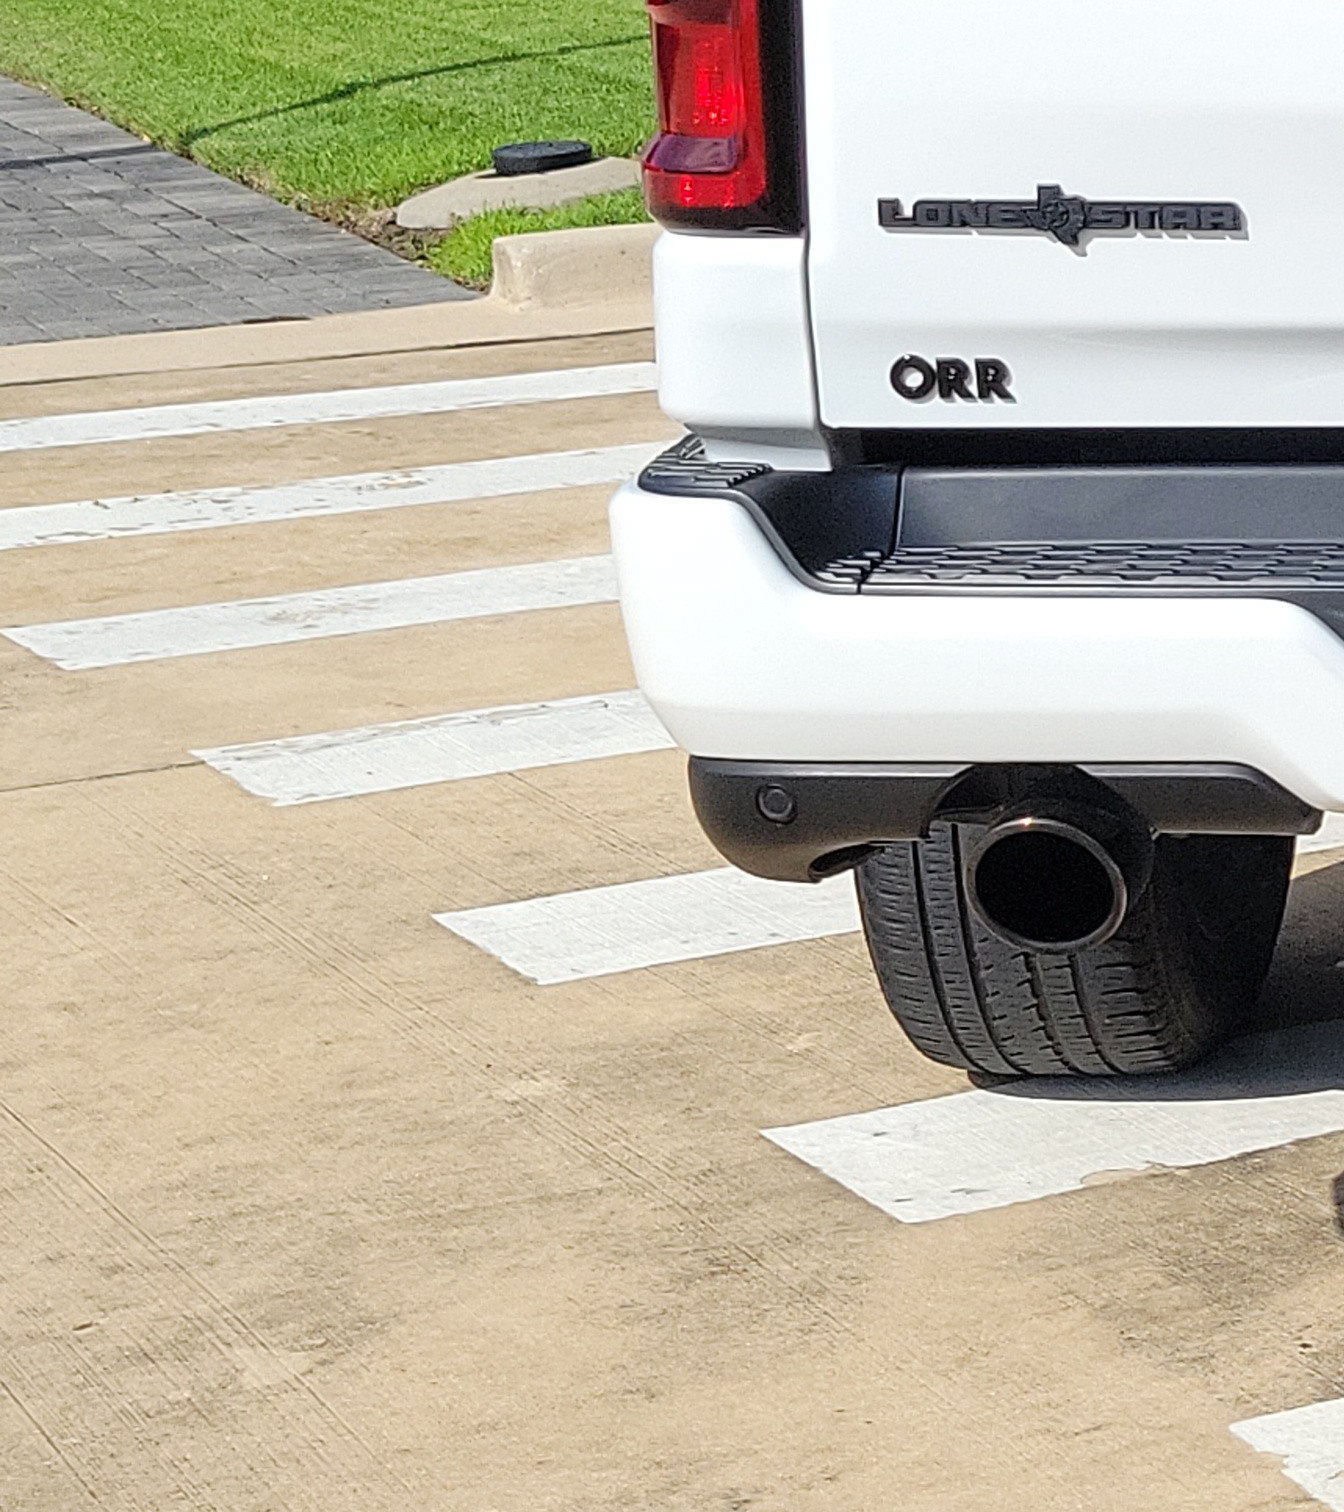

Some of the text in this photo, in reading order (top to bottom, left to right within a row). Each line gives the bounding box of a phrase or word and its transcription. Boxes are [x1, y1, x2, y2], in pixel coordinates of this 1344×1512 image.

[878, 198, 1245, 233] LONE STAR
[890, 353, 1016, 403] ORR
